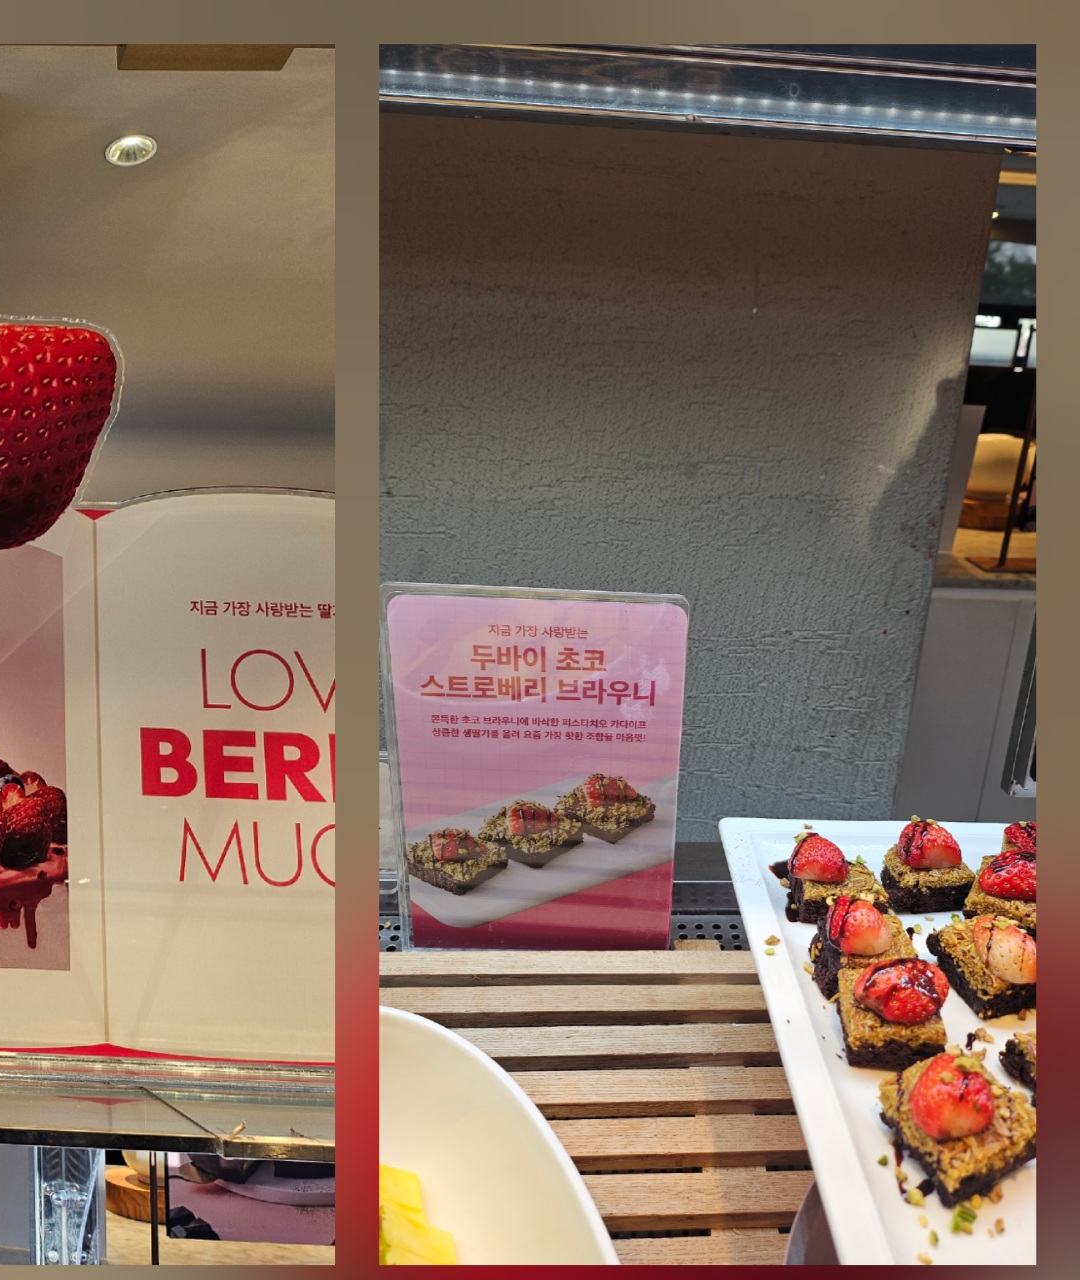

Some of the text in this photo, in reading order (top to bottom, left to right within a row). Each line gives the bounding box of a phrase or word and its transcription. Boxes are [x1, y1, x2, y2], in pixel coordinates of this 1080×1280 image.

[190, 600, 335, 619] 지금 가장 사랑받는 딸
[488, 624, 589, 639] 지금 가장 사랑받는
[470, 644, 607, 673] 두바이 초코
[420, 675, 656, 707] 스트로베리 브라우니
[431, 714, 648, 730] 쫀득한 초코 브라우니에 바삭한 피스타치오 카다이프
[462, 728, 500, 739] 생딸기를
[502, 728, 520, 739] 올려
[523, 729, 542, 741] 요즘
[544, 730, 562, 741] 가장
[140, 727, 335, 803] BER
